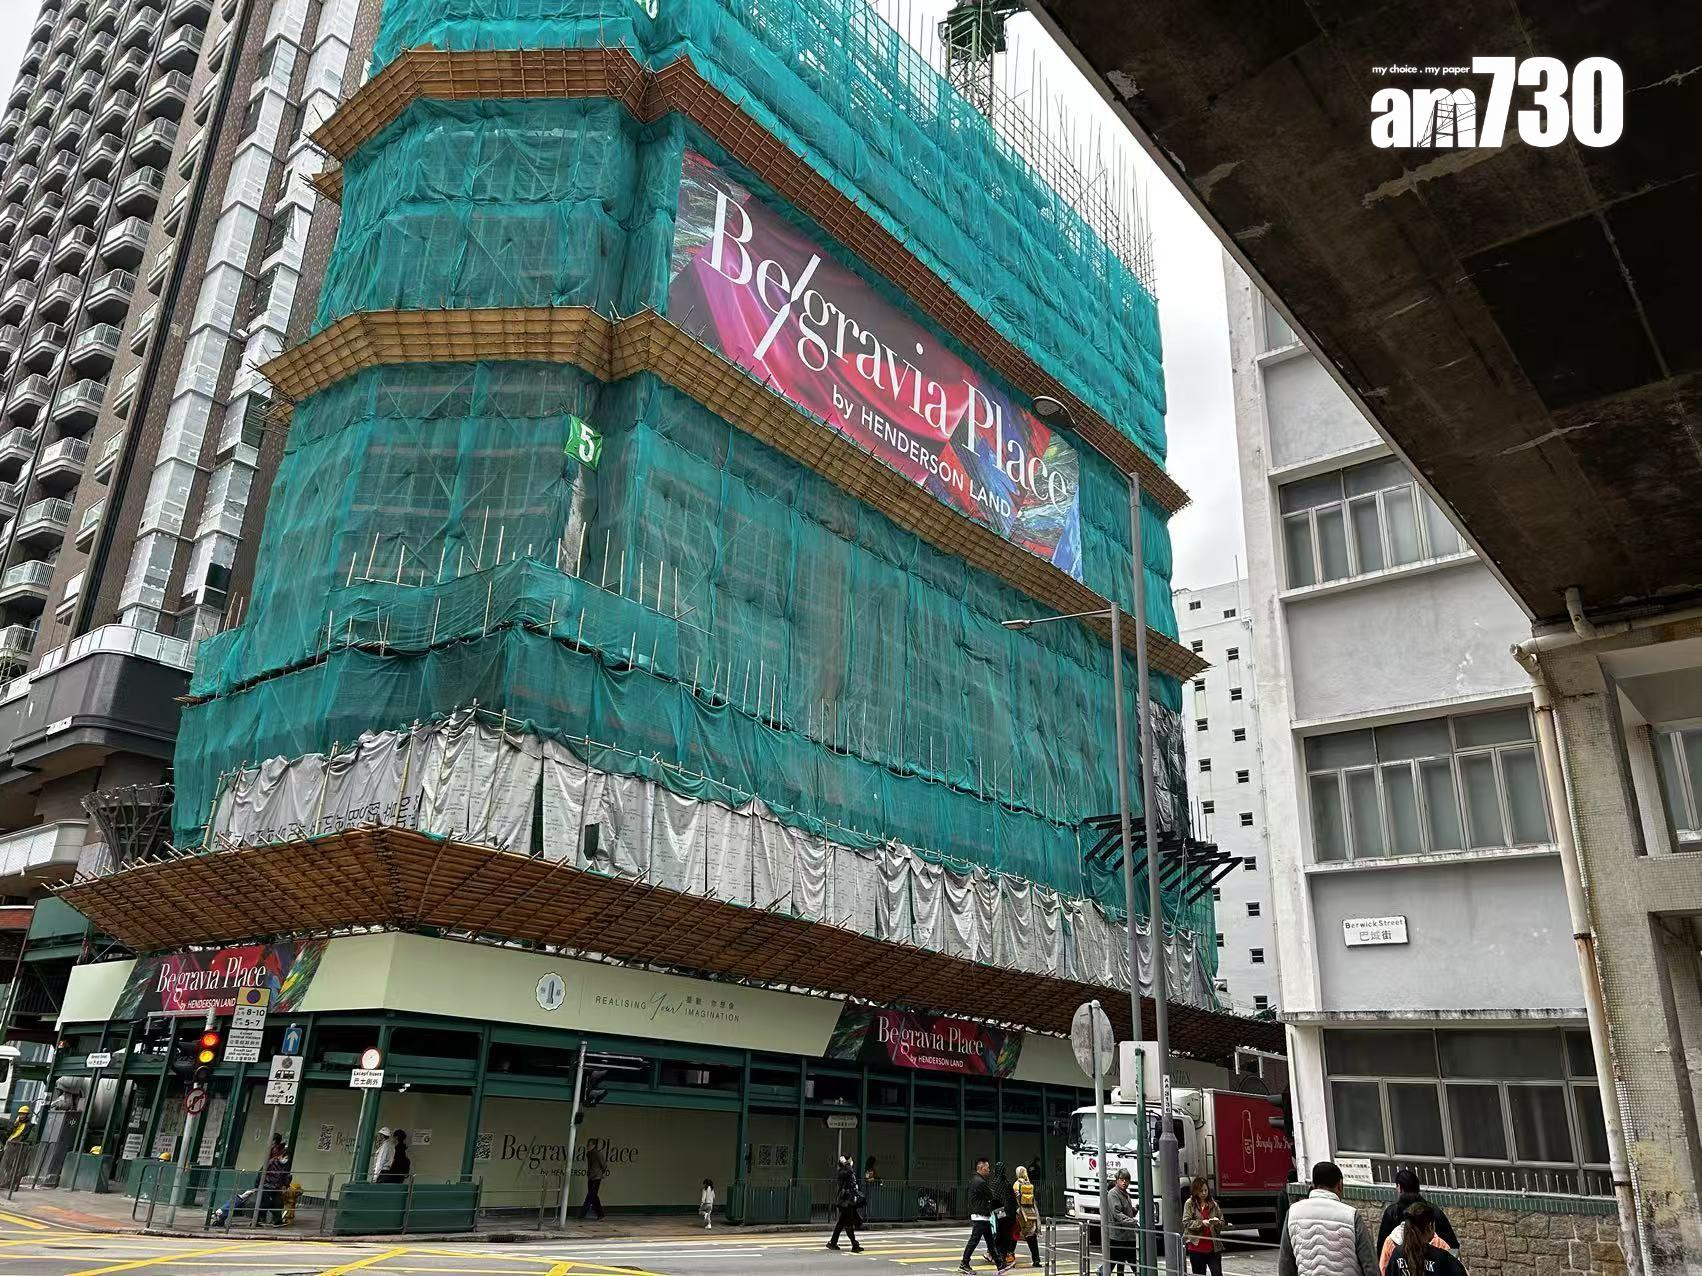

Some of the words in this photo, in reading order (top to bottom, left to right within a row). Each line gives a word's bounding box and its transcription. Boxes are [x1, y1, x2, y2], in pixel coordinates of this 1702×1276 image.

[701, 182, 957, 441] Belgravia
[961, 379, 1068, 515] Place
[579, 423, 595, 463] 5
[832, 385, 855, 419] by
[860, 406, 964, 493] HENDERSON
[968, 474, 1012, 519] LAND
[1345, 920, 1377, 929] Berwick
[1378, 919, 1403, 927] Street
[155, 959, 220, 1003] Belgravia
[222, 956, 267, 989] Place
[187, 998, 220, 1009] HENDERSON
[220, 997, 236, 1008] LAND
[595, 995, 647, 1010] REALISING
[246, 1008, 265, 1017] 8-10
[684, 1008, 740, 1023] IMAGINATION
[244, 1019, 261, 1027] 5-7
[878, 1016, 944, 1055] Belgravia
[947, 1026, 985, 1057] Place
[918, 1056, 950, 1067] HENDERSON
[950, 1059, 964, 1068] LAND
[287, 1082, 293, 1091] 7
[354, 1078, 379, 1086] 巴士例外
[285, 1095, 295, 1104] 12
